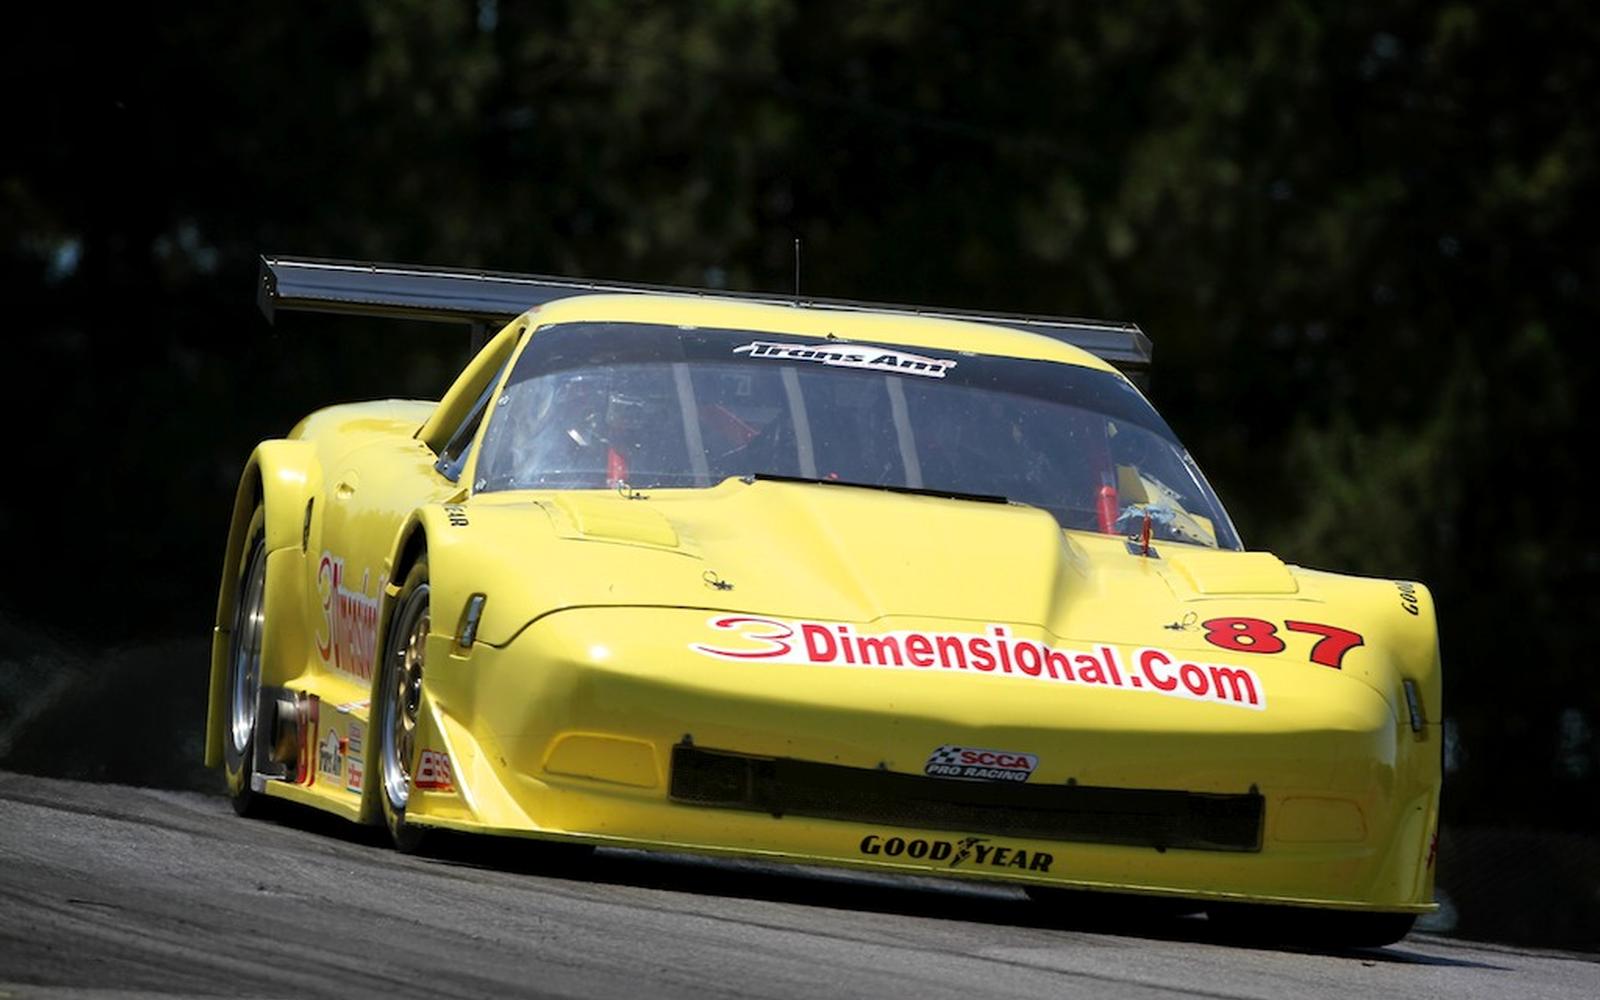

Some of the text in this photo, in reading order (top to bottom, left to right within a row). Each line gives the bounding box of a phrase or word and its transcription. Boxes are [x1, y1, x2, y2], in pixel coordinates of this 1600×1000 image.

[751, 342, 947, 376] Trans Am
[1201, 616, 1365, 670] 87
[926, 763, 1028, 782] PRO RACING
[960, 751, 1032, 770] SCCA
